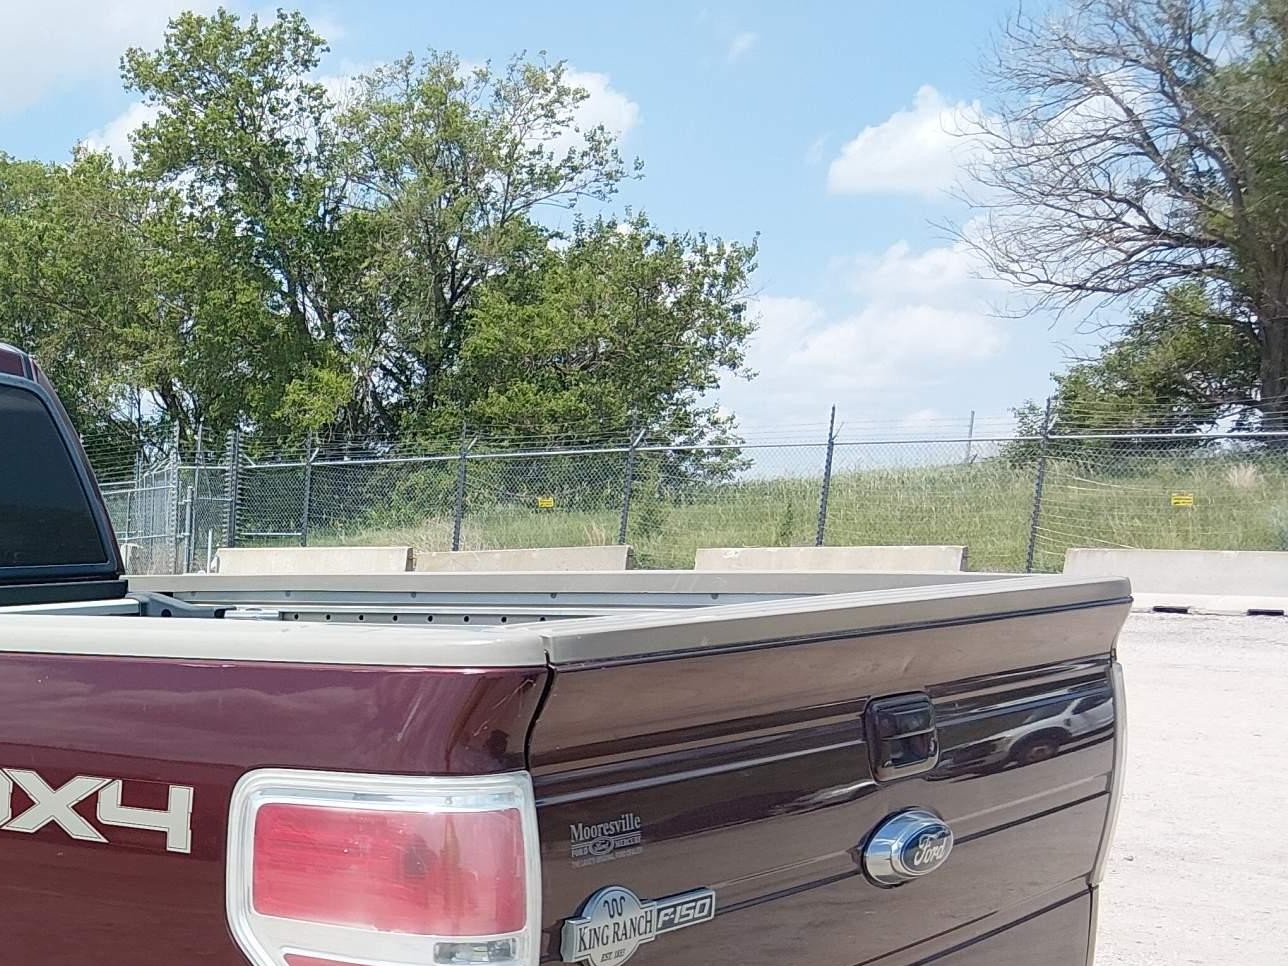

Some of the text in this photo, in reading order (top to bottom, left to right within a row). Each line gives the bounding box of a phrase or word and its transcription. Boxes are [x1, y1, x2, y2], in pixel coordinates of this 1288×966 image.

[569, 812, 641, 843] Mooresville
[914, 830, 950, 866] Ford
[657, 897, 711, 929] F-150
[578, 909, 653, 953] KING RANCH
